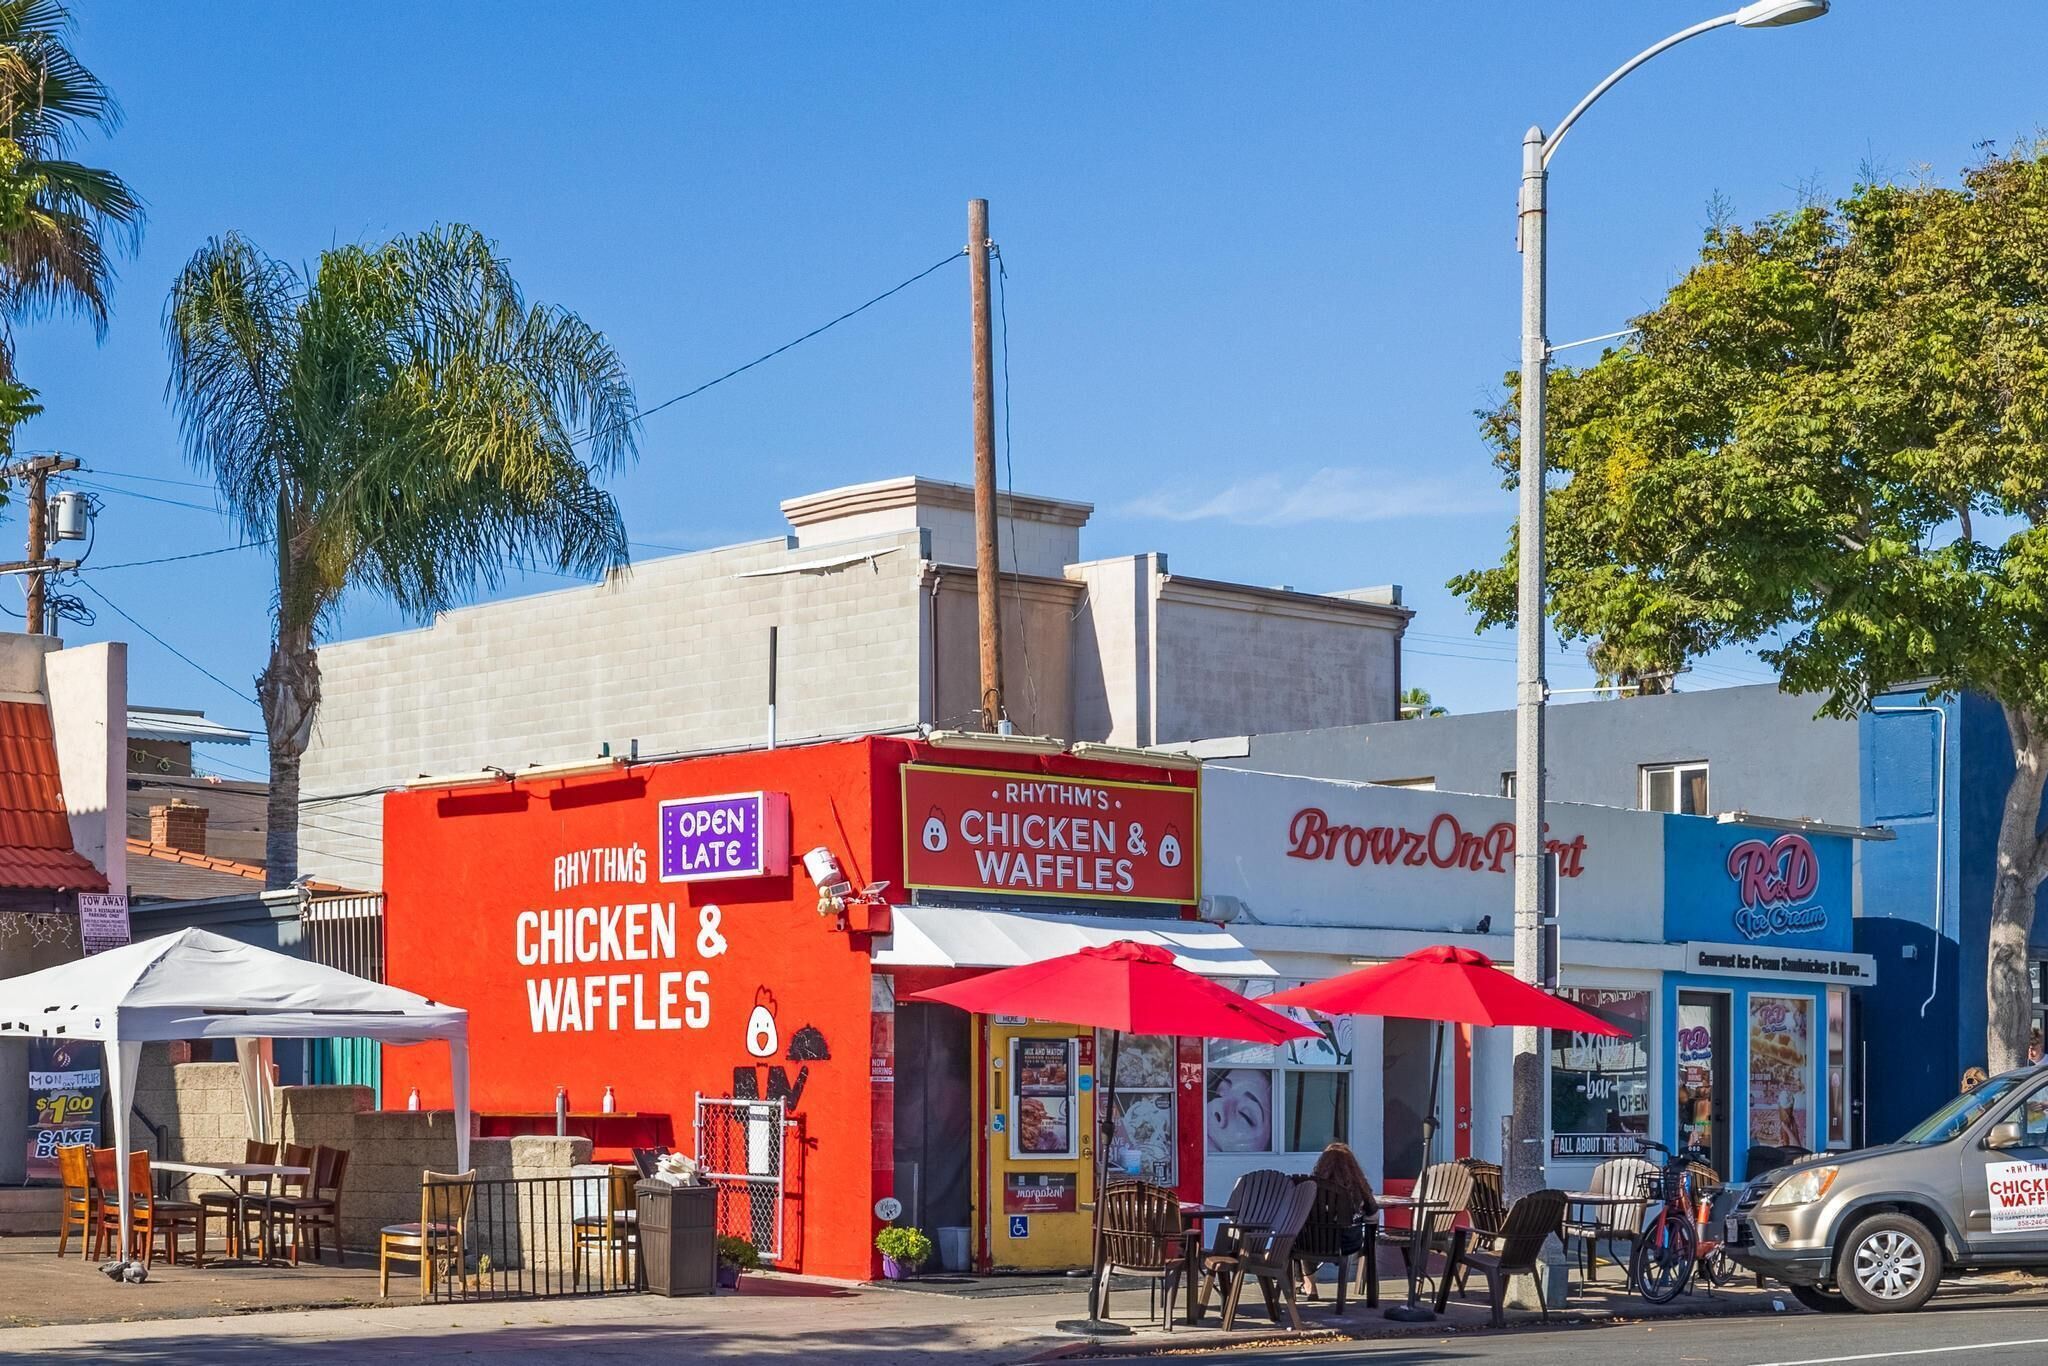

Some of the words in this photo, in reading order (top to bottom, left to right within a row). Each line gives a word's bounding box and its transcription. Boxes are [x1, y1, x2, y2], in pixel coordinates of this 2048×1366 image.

[1006, 783, 1109, 810] RHYTHM'S
[679, 807, 744, 839] OPEN
[959, 809, 1116, 853] CHICKEN
[1127, 822, 1148, 857] &
[554, 842, 647, 892] RHYTHM'S
[681, 840, 742, 871] LATE
[975, 850, 1135, 893] WAFFLES
[81, 896, 100, 906] TOW
[102, 896, 125, 906] AWAY
[516, 903, 676, 966] CHICKEN
[696, 903, 728, 959] &
[1736, 908, 1769, 938] Ice
[1768, 906, 1827, 935] Cream
[1699, 952, 1736, 968] Gourmet
[1737, 954, 1750, 969] Ice
[1752, 955, 1780, 971] Cream
[1781, 957, 1829, 974] Sandwiches
[1830, 961, 1839, 976] &
[526, 970, 710, 1033] WAFFLES
[872, 1058, 886, 1067] NOW
[872, 1067, 893, 1076] HIRING
[1620, 1093, 1648, 1113] OPEN
[38, 1129, 94, 1144] SAKE
[1576, 1136, 1600, 1153] ABOUT
[1602, 1136, 1616, 1153] THE
[2000, 1192, 2048, 1207] WAFF
